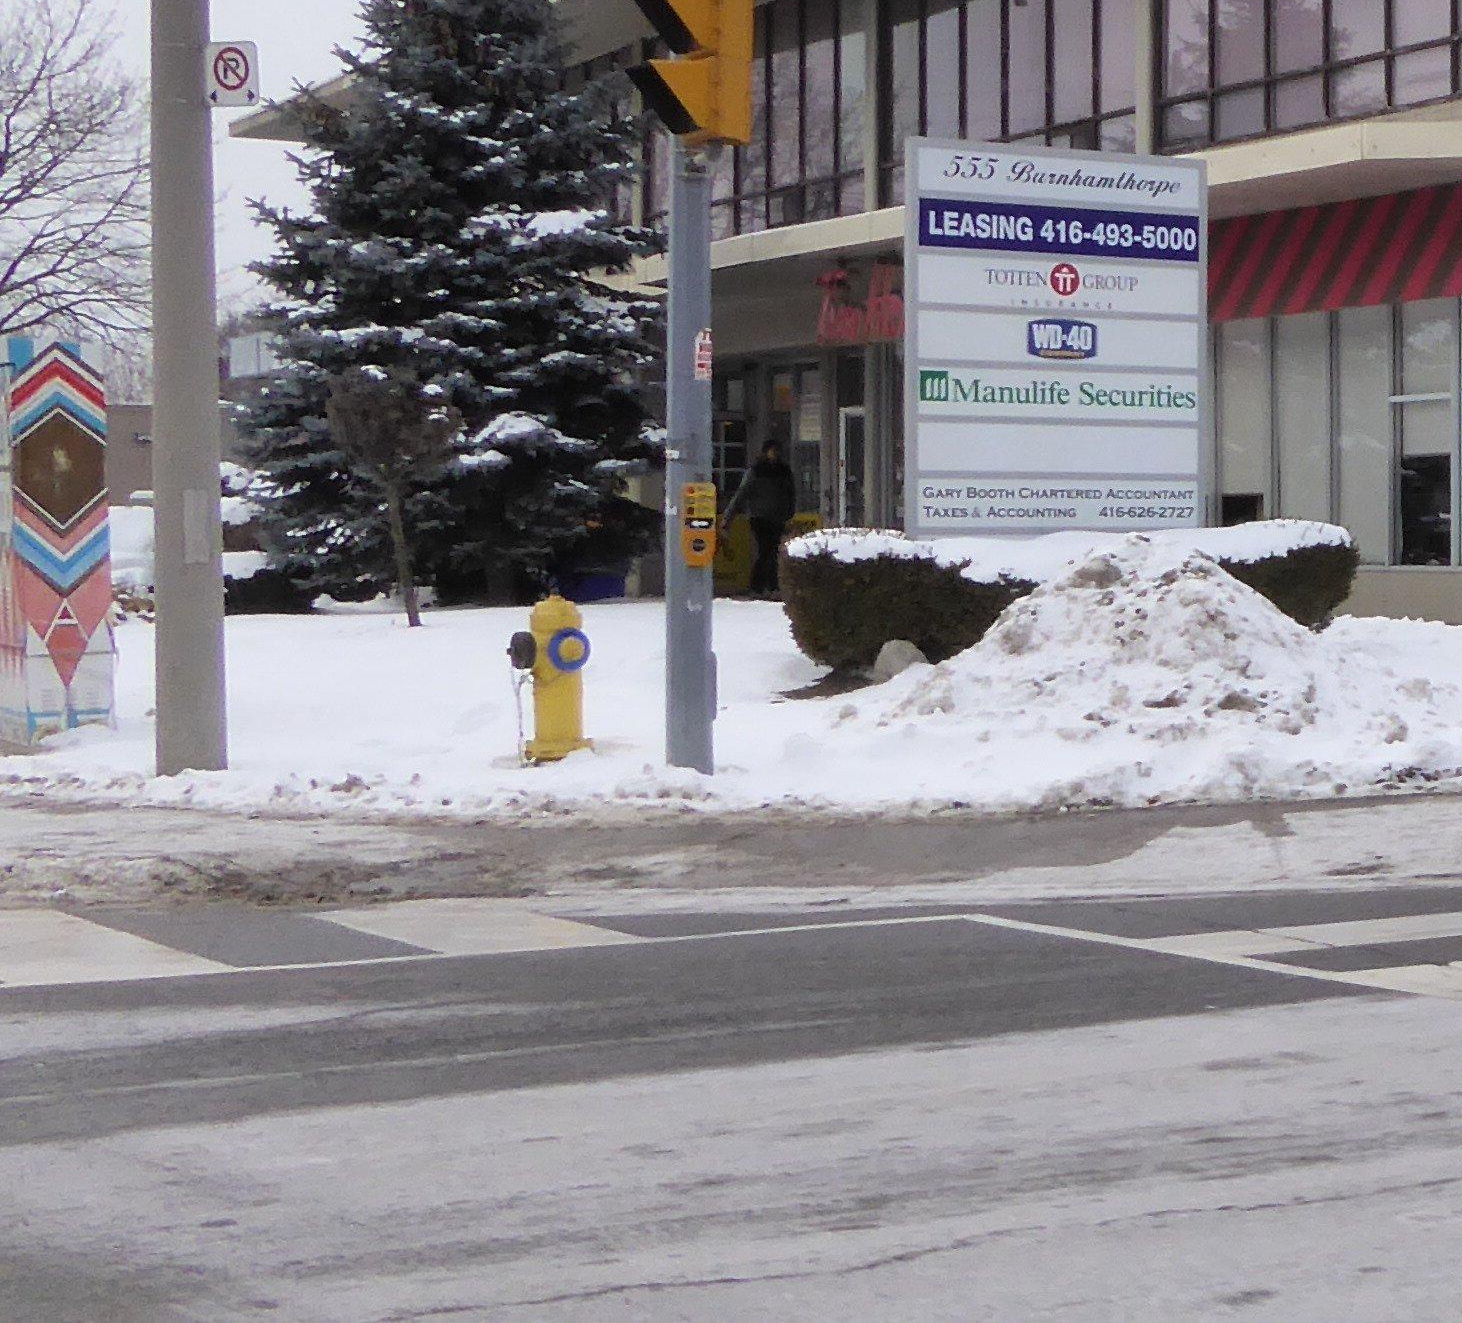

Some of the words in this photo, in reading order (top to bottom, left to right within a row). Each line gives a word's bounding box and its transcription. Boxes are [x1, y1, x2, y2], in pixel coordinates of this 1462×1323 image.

[943, 155, 1000, 180] 555
[1007, 159, 1183, 198] Burnhamthorpe
[928, 210, 1034, 242] LEASING
[1040, 218, 1198, 252] 416-493-5000
[985, 268, 1048, 286] TOTTEN
[1083, 274, 1140, 292] GROUP
[1032, 324, 1093, 350] WD-40
[952, 378, 1071, 405] Manulife
[1079, 381, 1197, 409] Securities
[922, 486, 962, 500] GARY
[966, 486, 1016, 500] BOOTH
[1018, 487, 1102, 500] CHARTERED
[1106, 488, 1195, 501] ACCOUNTANT
[923, 505, 968, 518] TAXES
[971, 507, 981, 518] &
[986, 505, 1077, 519] ACCOUNTING
[1098, 506, 1195, 519] 416-626-2727
